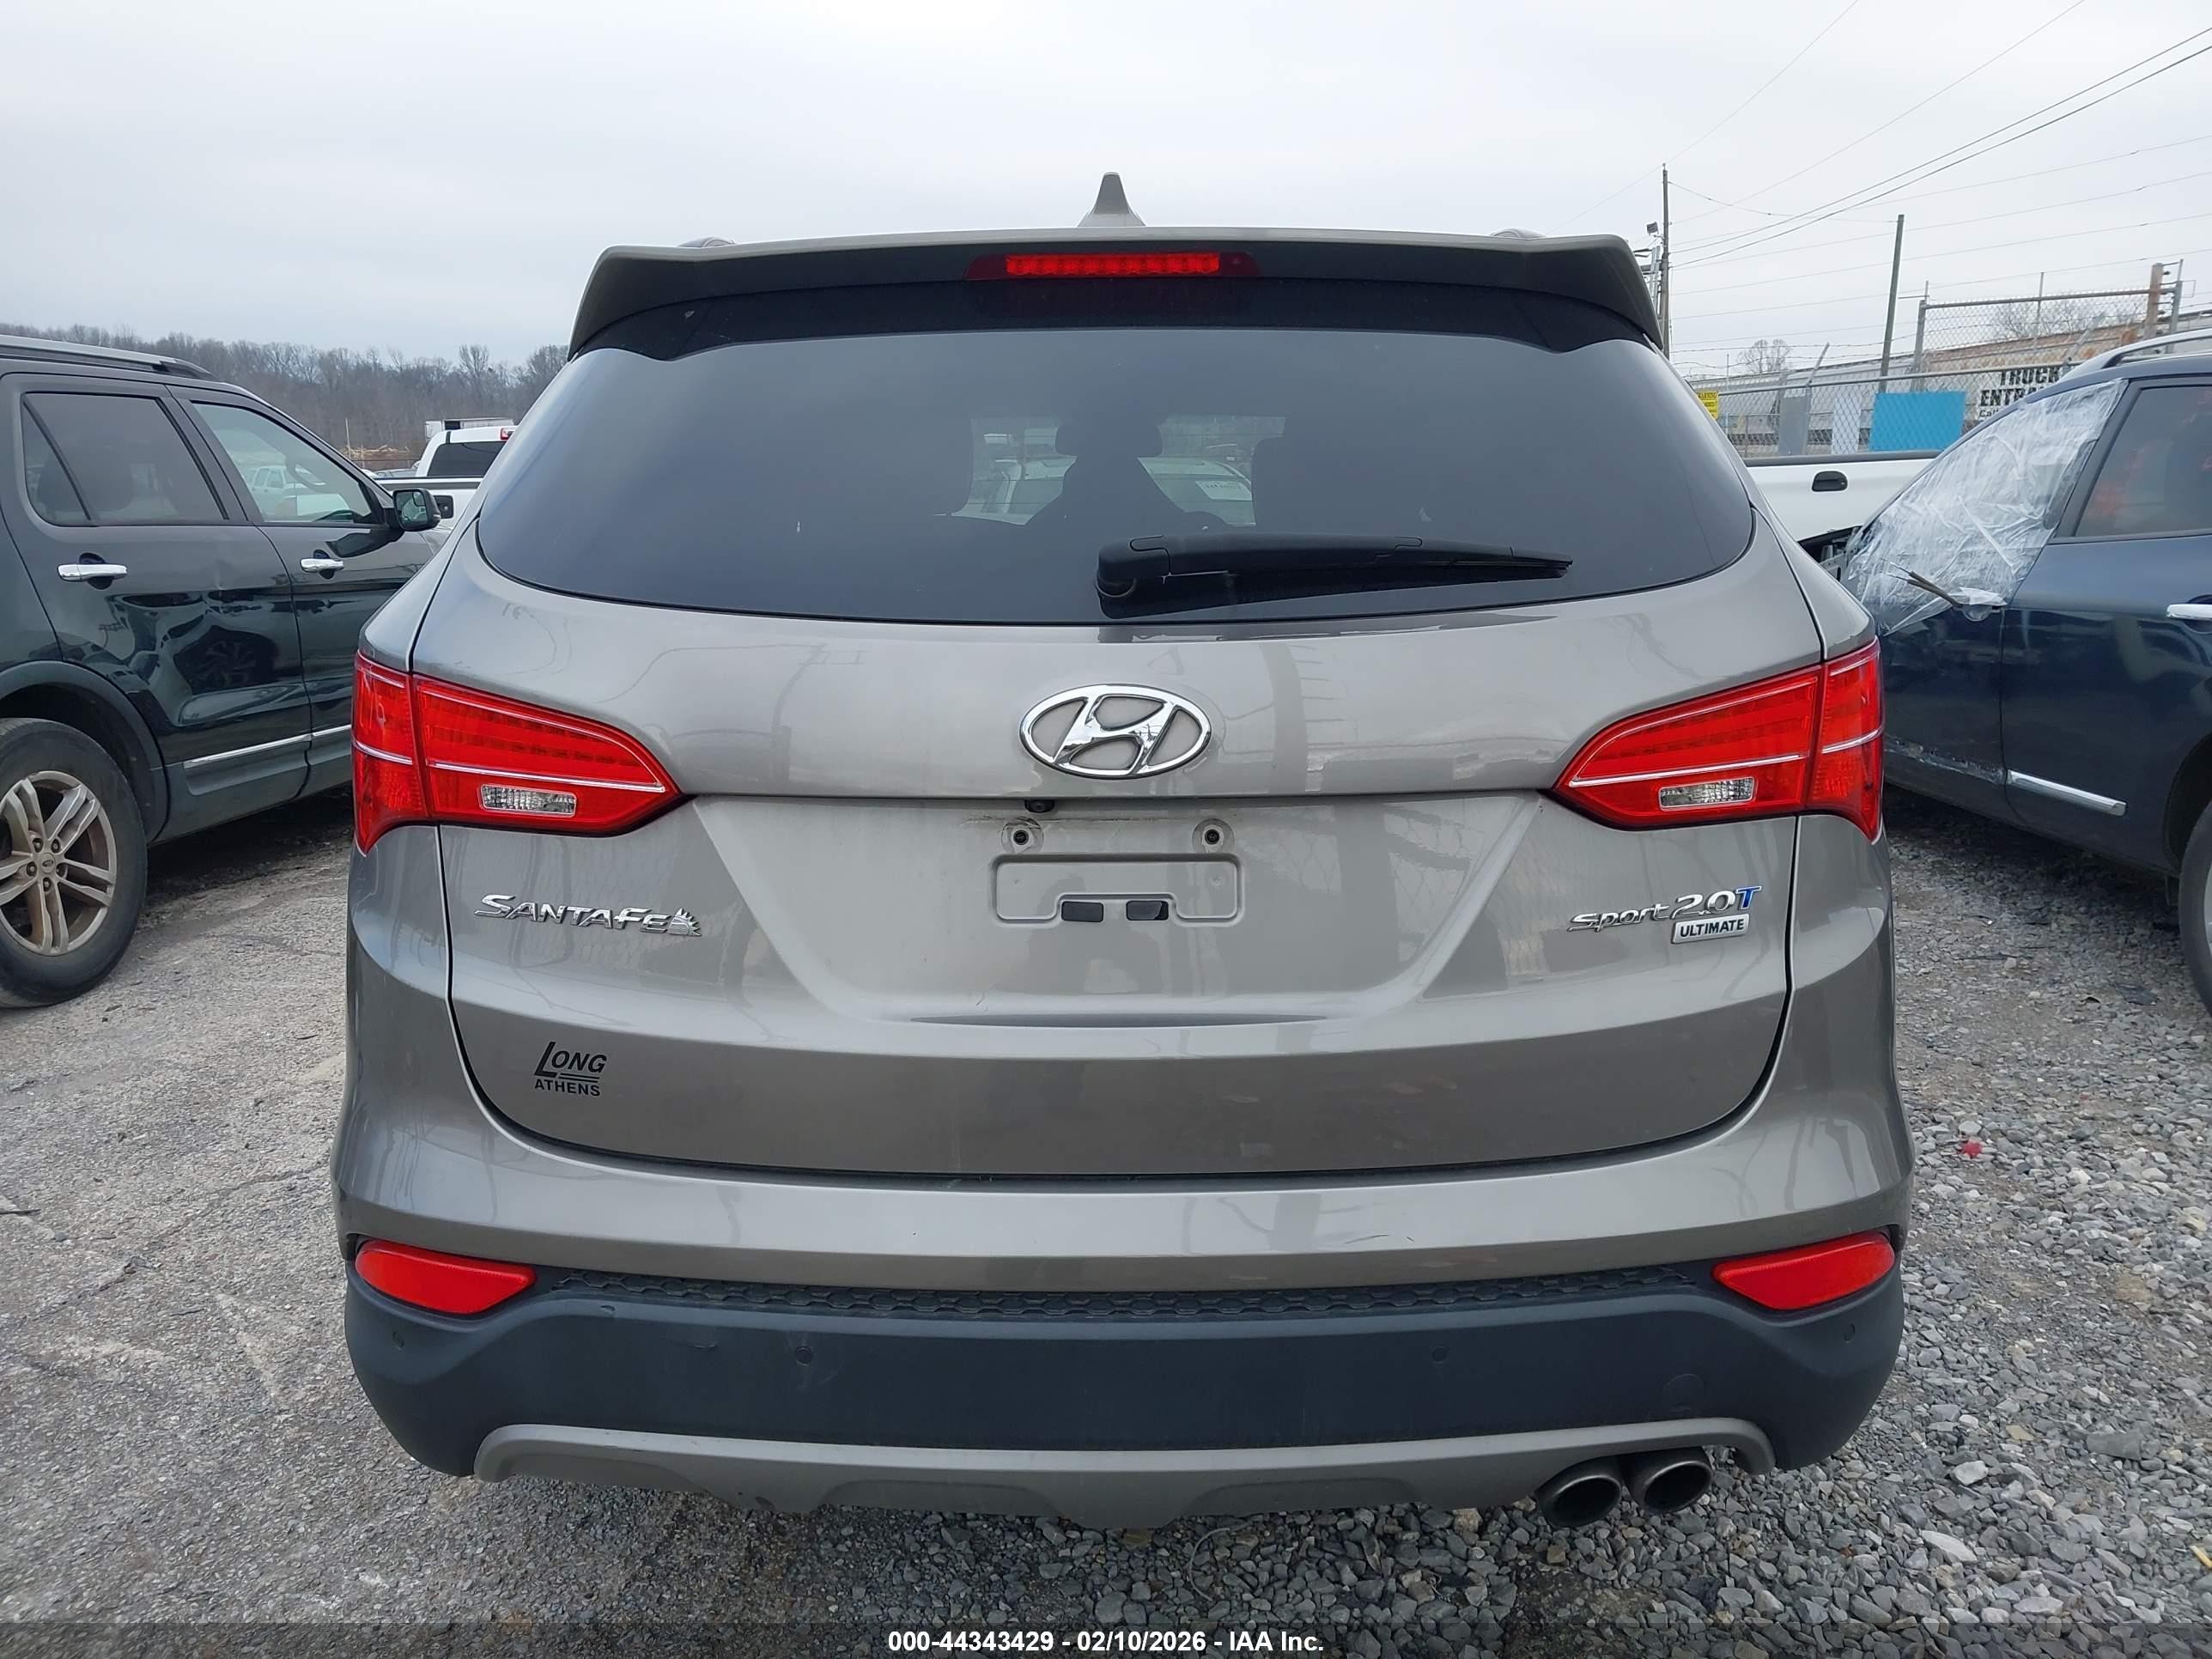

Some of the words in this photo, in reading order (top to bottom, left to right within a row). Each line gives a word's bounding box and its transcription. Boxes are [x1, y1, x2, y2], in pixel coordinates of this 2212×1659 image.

[1999, 366, 2060, 386] TRUCK
[1680, 919, 1744, 938] ULTIMATE
[534, 1041, 607, 1079] LONG
[534, 1079, 600, 1097] ATHENS
